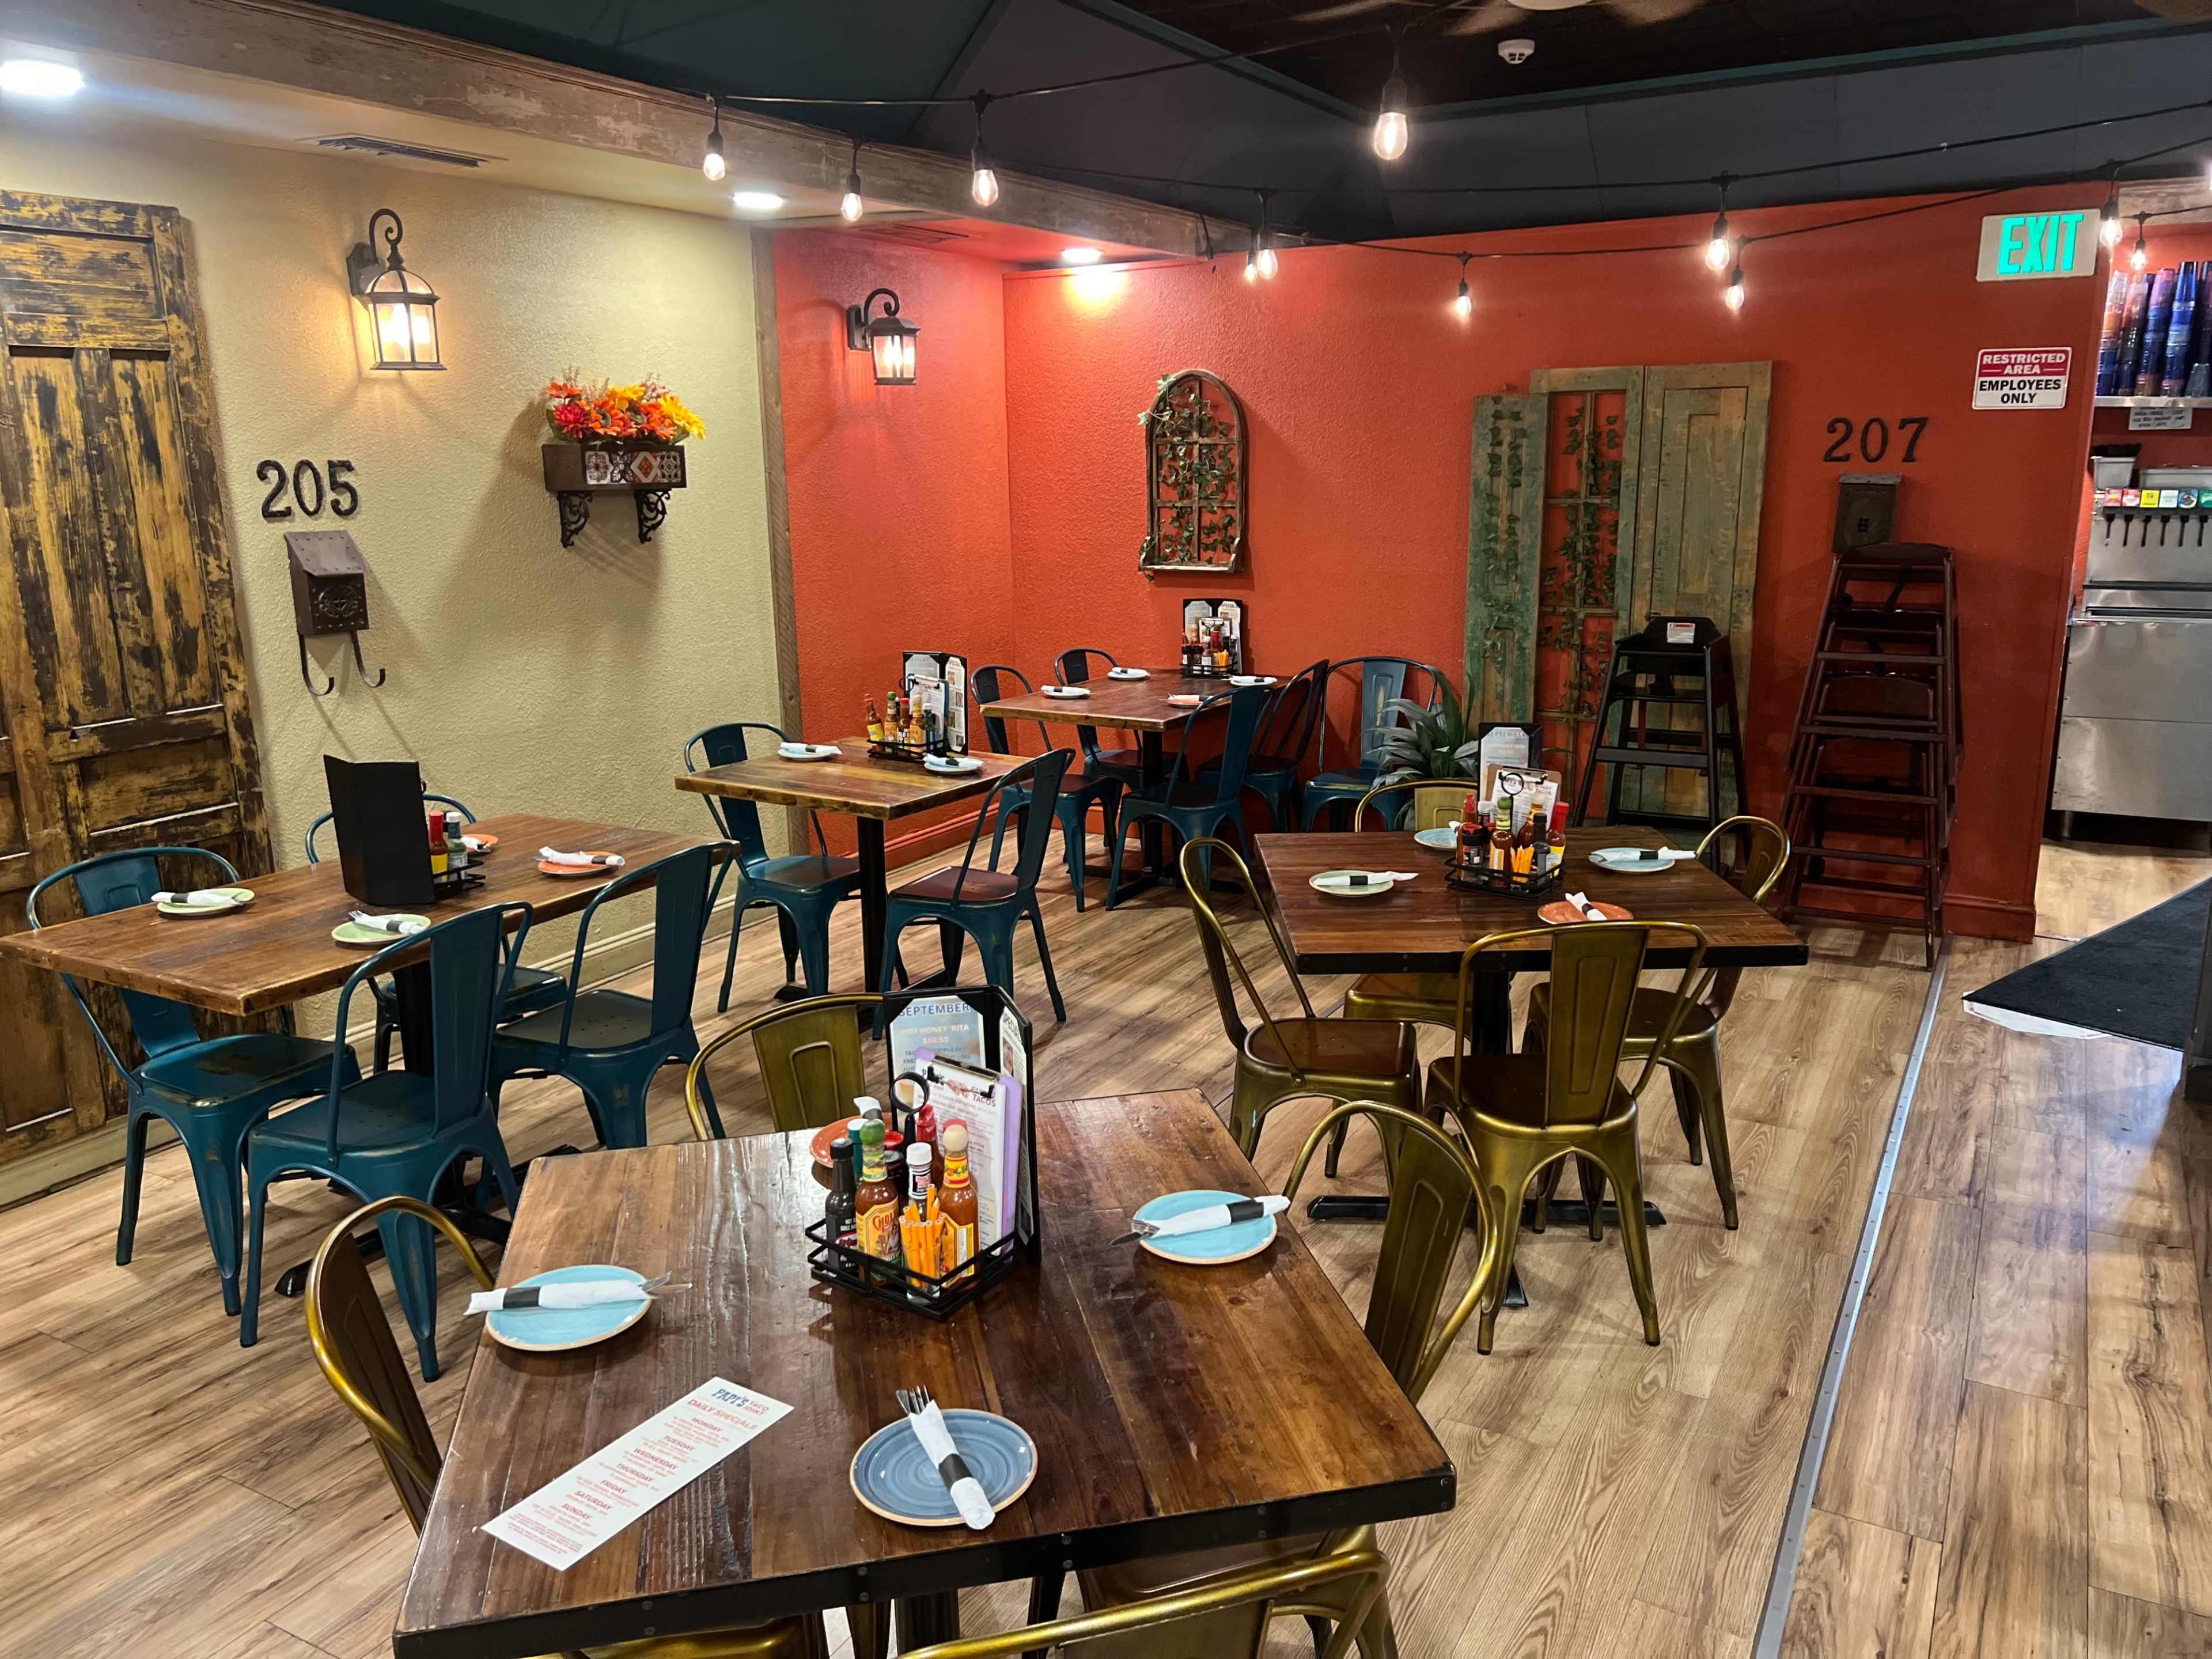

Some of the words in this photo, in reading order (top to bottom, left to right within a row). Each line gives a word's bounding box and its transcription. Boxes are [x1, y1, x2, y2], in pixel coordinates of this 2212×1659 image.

[1998, 213, 2084, 274] EXIT
[1982, 353, 2066, 365] RESTRICTED
[2003, 365, 2041, 374] AREA
[1979, 379, 2061, 391] EMPLOYEES
[2001, 393, 2037, 404] ONLY
[1823, 417, 1929, 463] 207
[256, 459, 358, 518] 205
[973, 1094, 996, 1107] TACOS
[873, 1212, 894, 1232] CHOL
[711, 1388, 749, 1407] PAPI'S
[749, 1401, 770, 1411] TACO
[687, 1399, 716, 1412] DAILY
[714, 1410, 757, 1430] SPECIALS
[743, 1405, 766, 1416] JOINT
[691, 1417, 722, 1432] MONDAY
[663, 1435, 695, 1450] TUESDAY
[634, 1448, 678, 1469] WEDNESDAY
[616, 1463, 654, 1482] THURSDAY
[600, 1479, 627, 1494] FRIDAY
[575, 1490, 613, 1510] SATURDAY
[562, 1503, 592, 1520] SUNDAY
